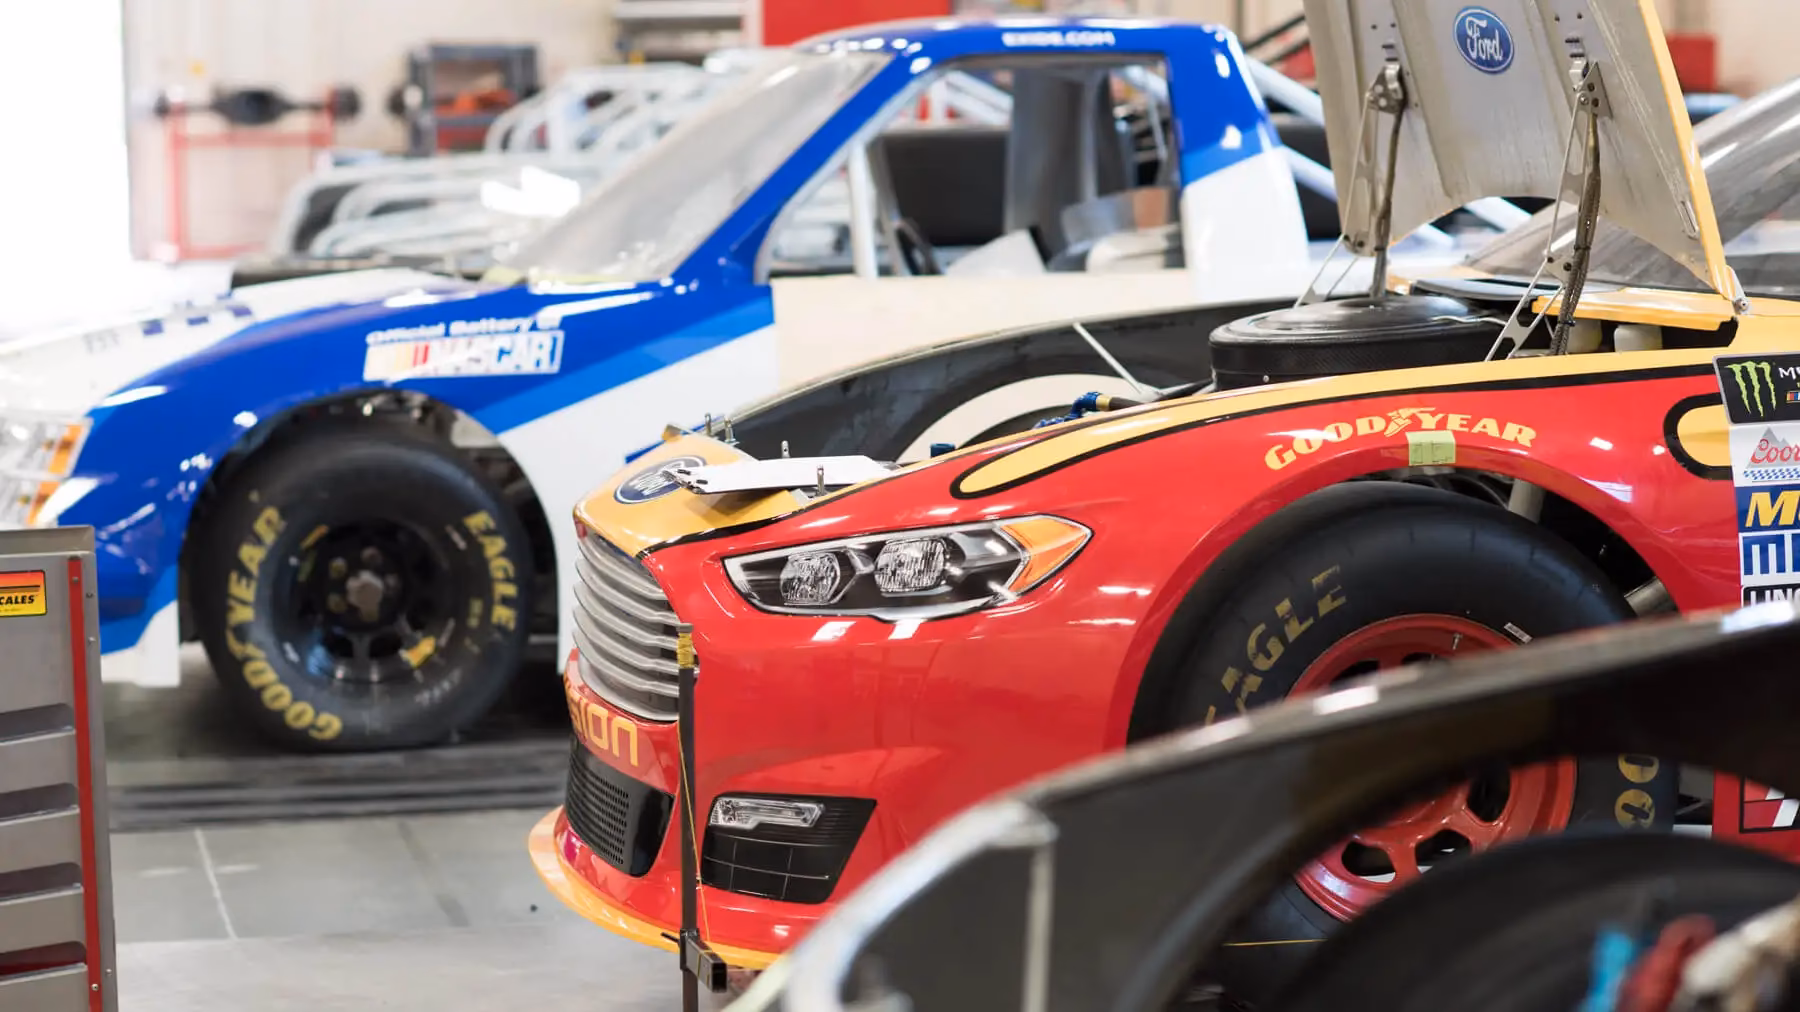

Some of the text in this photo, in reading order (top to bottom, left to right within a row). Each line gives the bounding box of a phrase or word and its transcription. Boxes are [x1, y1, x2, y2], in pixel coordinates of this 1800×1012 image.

[1465, 16, 1503, 61] Ford
[425, 330, 561, 376] NASCAR
[1264, 407, 1537, 471] GOODYEAR
[1745, 489, 1800, 529] M
[463, 510, 518, 631] EAGLE
[226, 506, 344, 741] GOODYEAR
[1205, 564, 1346, 727] AGLE
